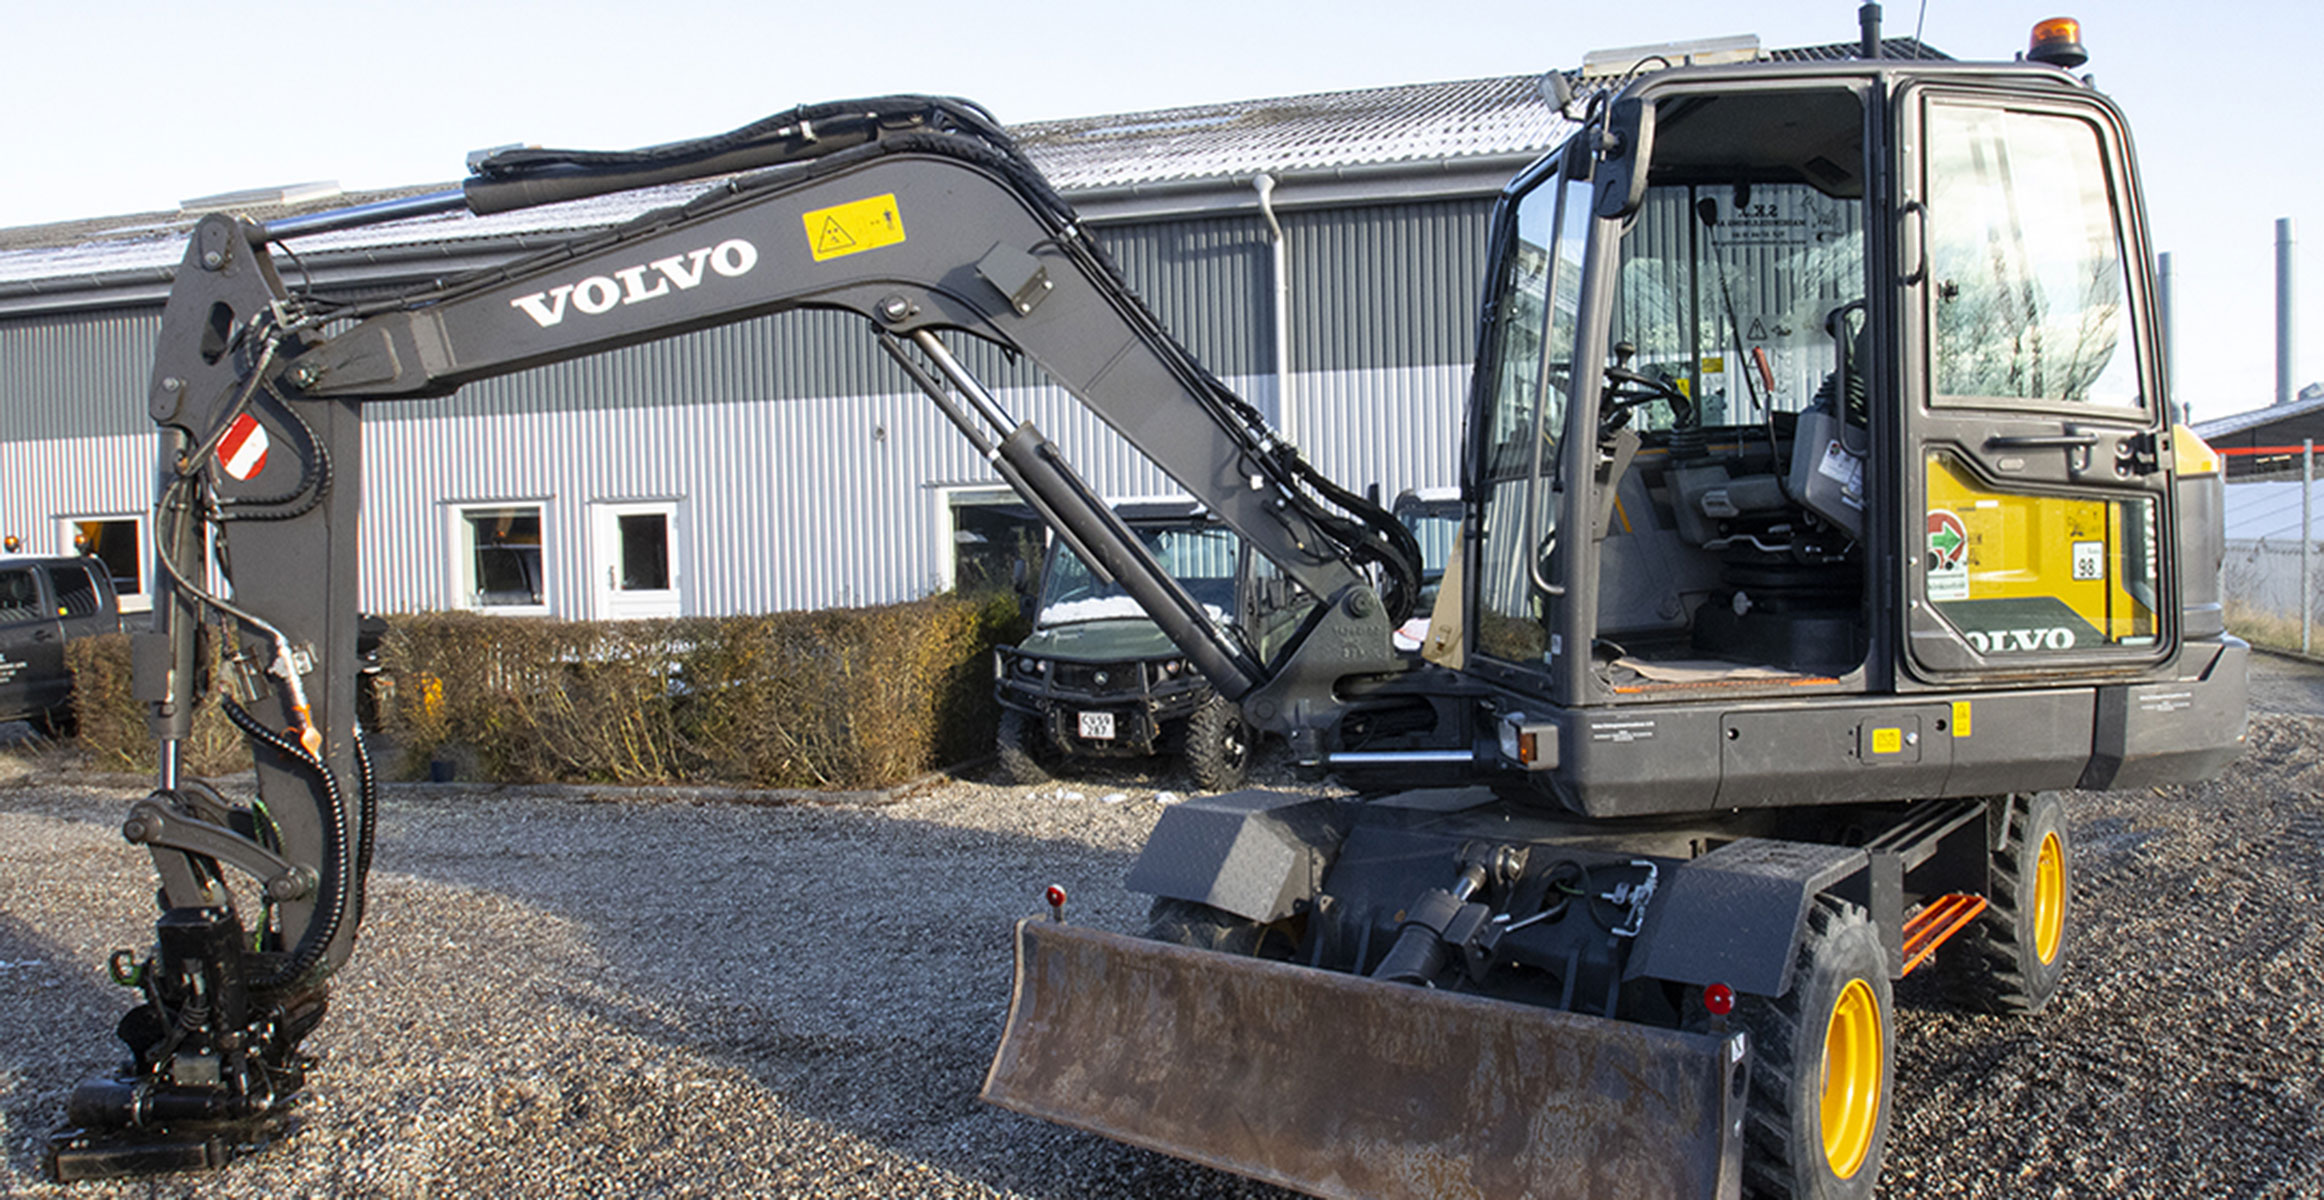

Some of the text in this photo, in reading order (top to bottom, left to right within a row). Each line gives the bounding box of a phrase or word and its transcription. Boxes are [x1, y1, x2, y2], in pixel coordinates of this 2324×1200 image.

[511, 238, 758, 328] VOLVO
[2078, 557, 2096, 577] 98
[1964, 626, 2076, 653] OLVO
